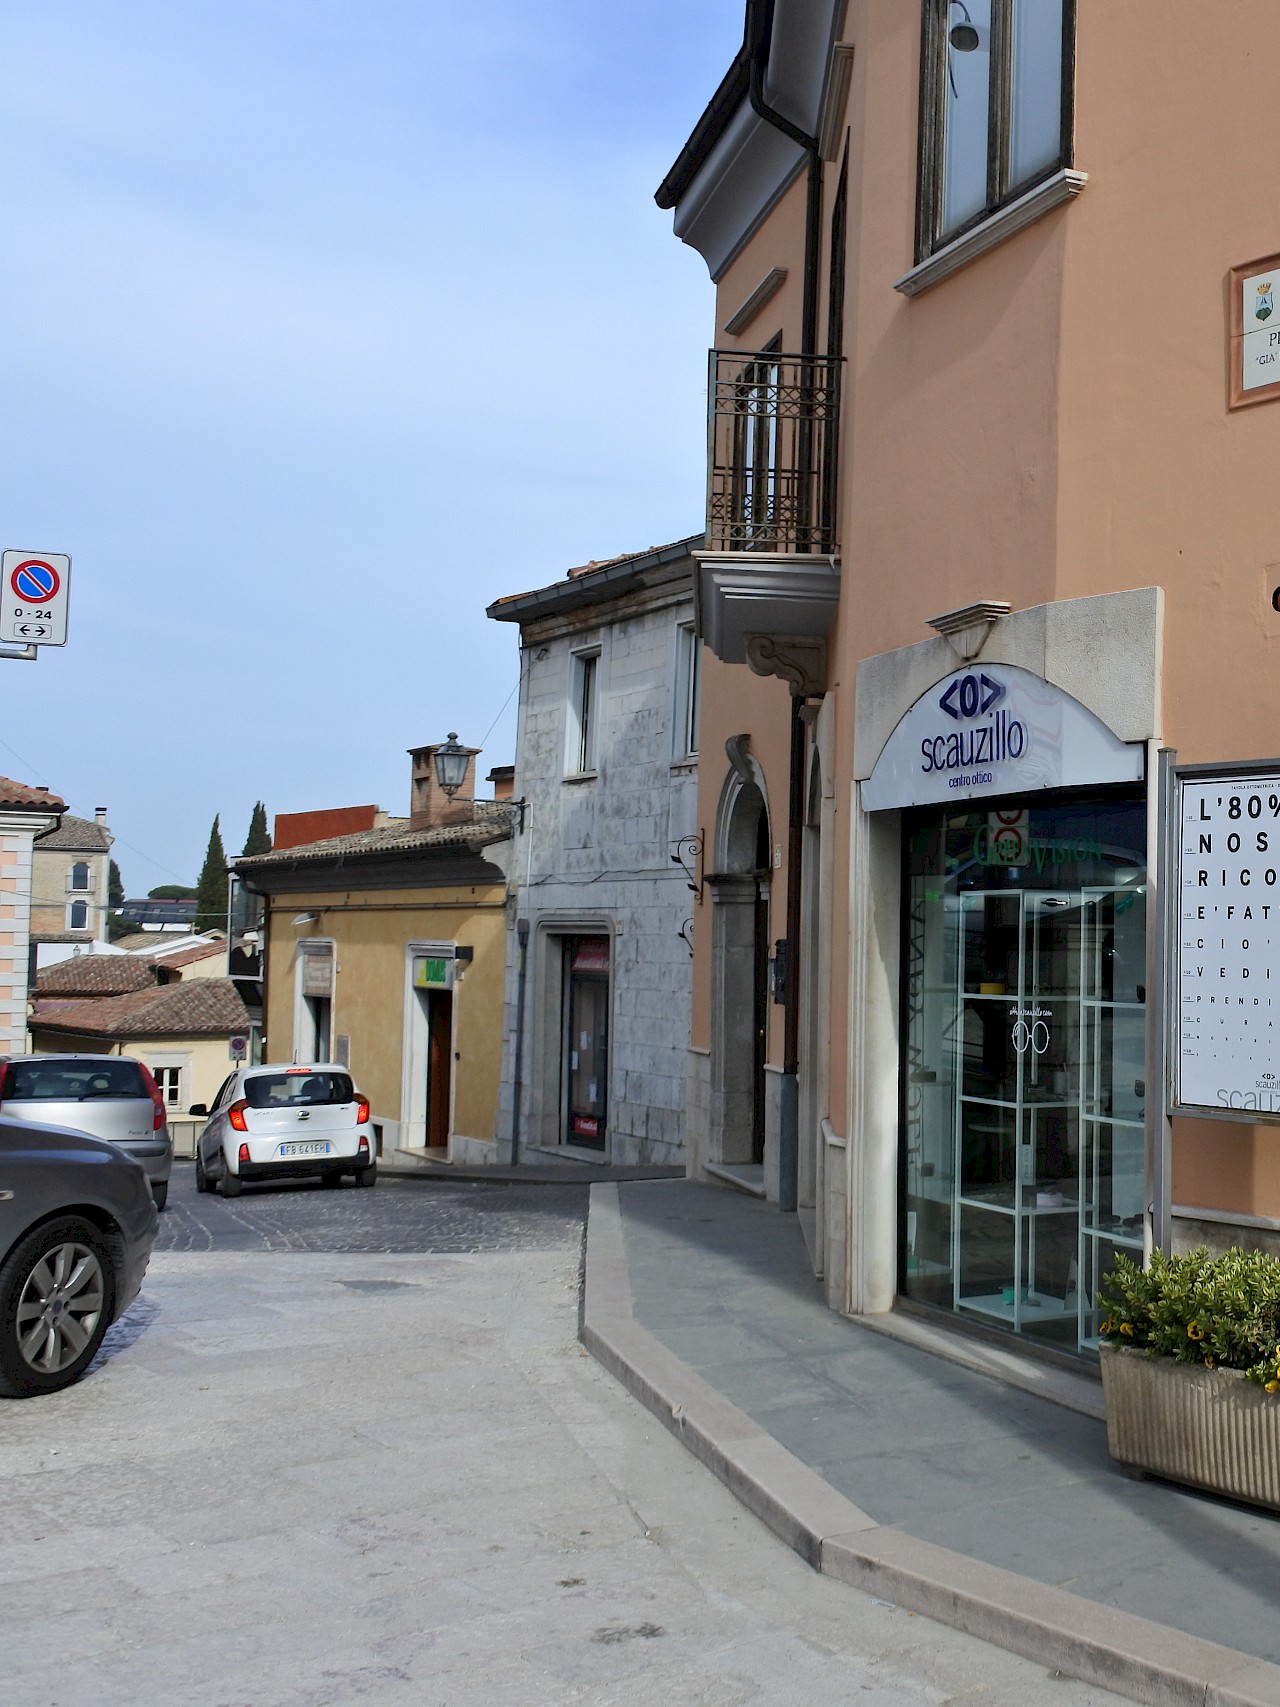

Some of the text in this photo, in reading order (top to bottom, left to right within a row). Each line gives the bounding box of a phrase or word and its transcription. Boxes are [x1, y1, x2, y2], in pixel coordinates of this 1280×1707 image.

[14, 608, 23, 617] 0
[35, 610, 52, 619] 24
[921, 709, 1026, 773] scauzillo
[949, 771, 993, 788] centro ottico
